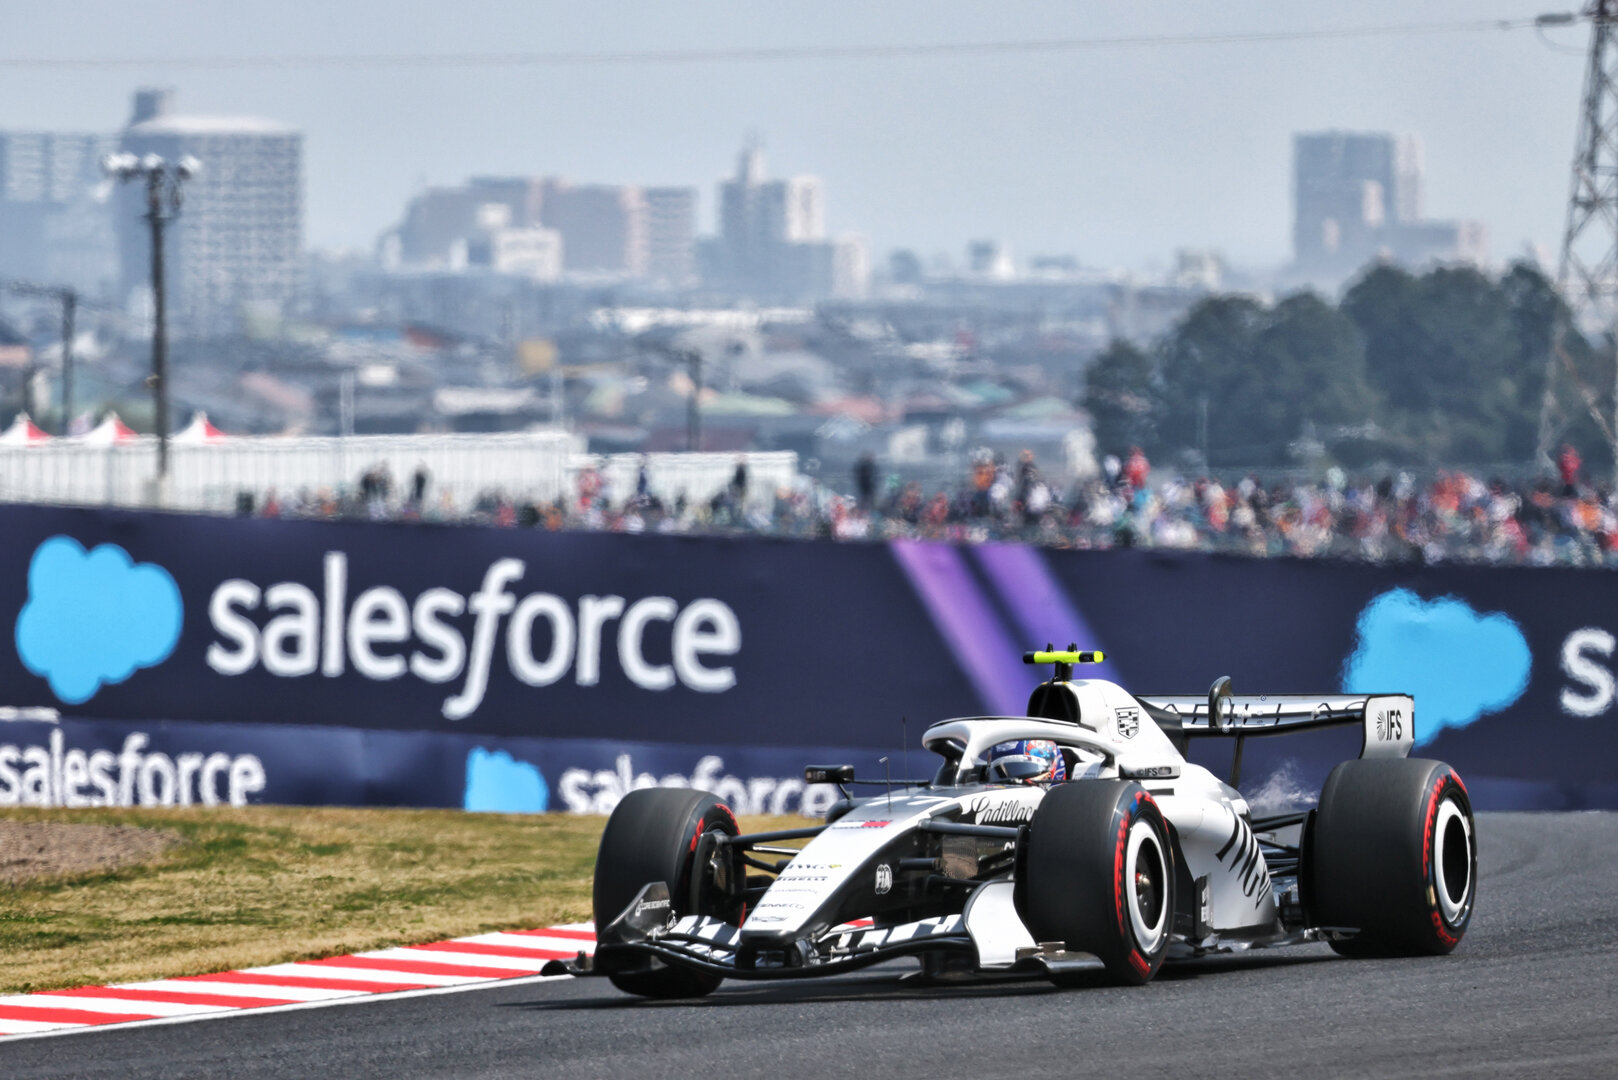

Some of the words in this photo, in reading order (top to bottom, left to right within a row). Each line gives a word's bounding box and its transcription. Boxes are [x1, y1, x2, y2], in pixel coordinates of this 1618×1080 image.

[207, 551, 742, 719] salesforce
[1386, 709, 1402, 740] IFS
[0, 728, 267, 807] salesforce
